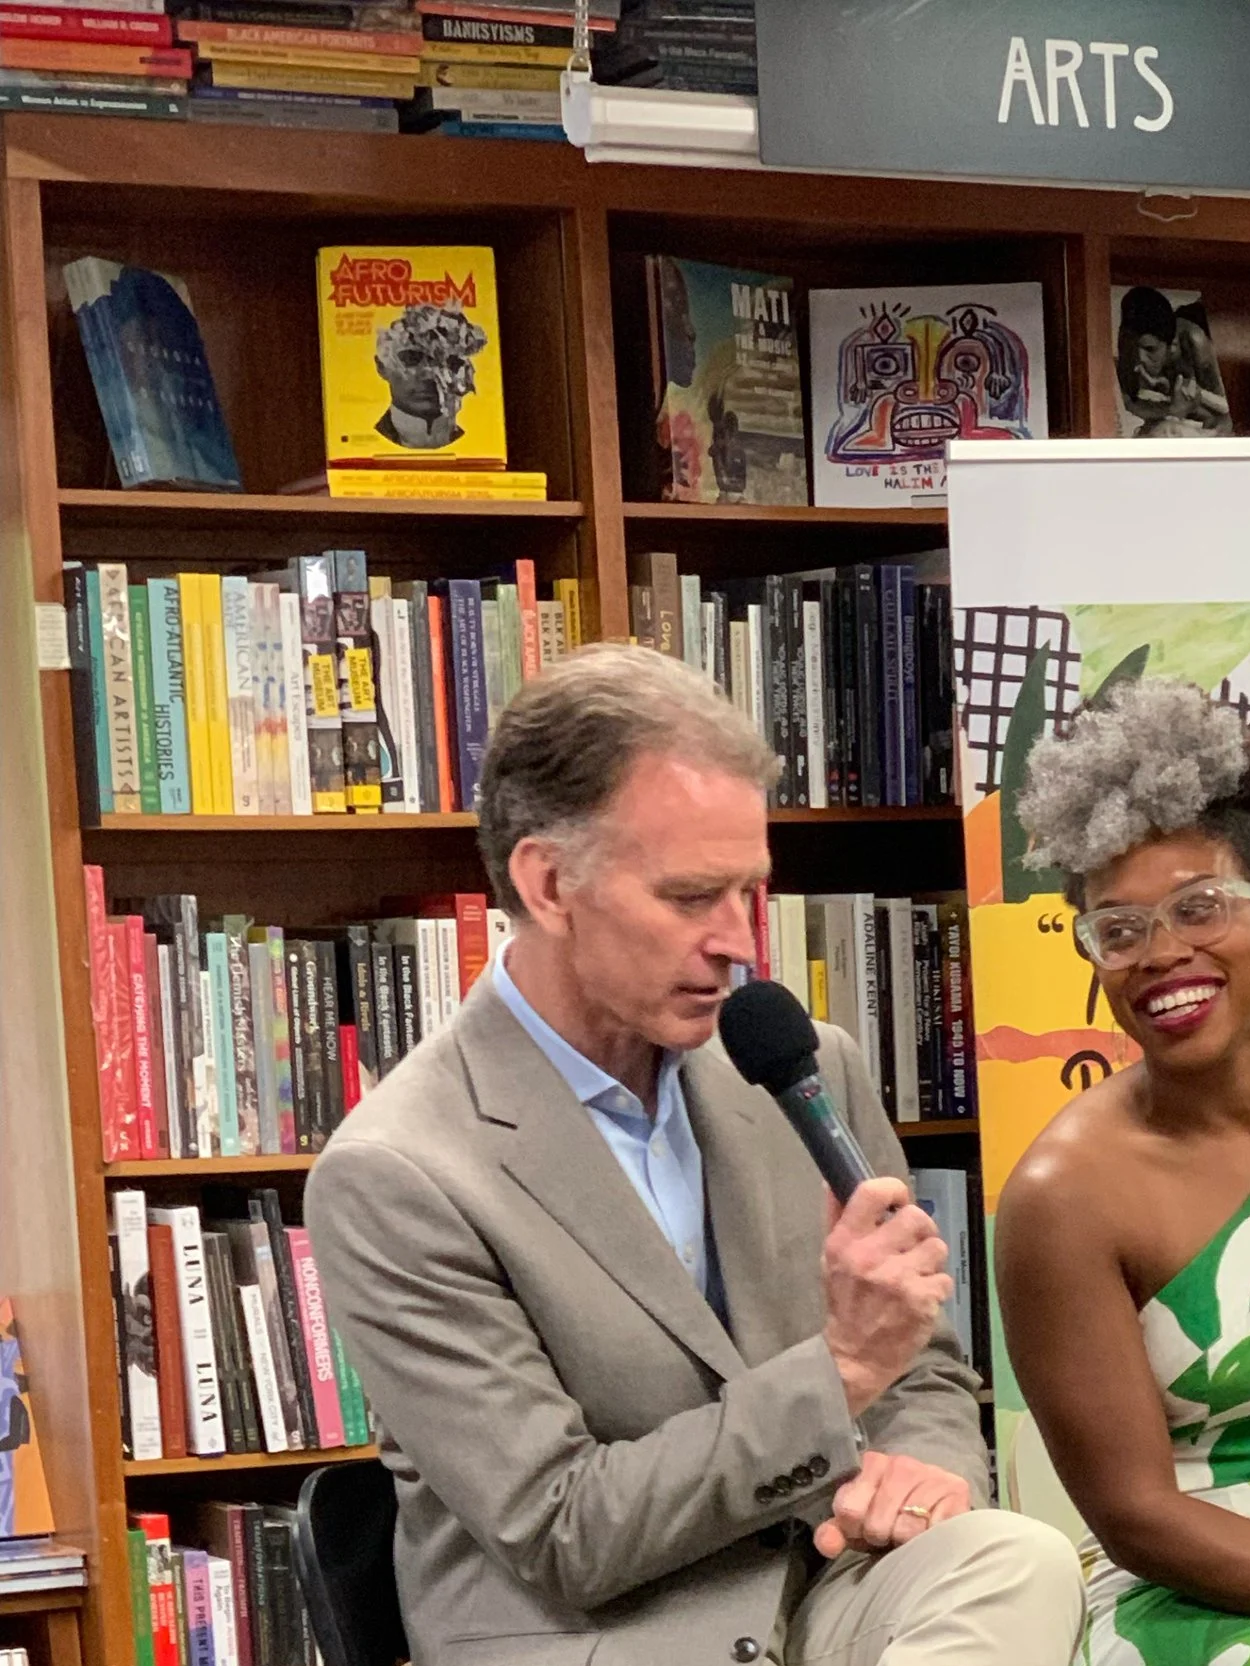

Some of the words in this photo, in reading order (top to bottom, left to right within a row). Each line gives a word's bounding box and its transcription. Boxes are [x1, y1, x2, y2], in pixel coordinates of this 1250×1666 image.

[442, 18, 536, 45] BANKSYISMS
[998, 36, 1174, 132] ARTS
[333, 255, 410, 282] AFRO
[333, 273, 476, 306] FUTURISM
[732, 283, 790, 325] MATI
[845, 465, 880, 477] LOVE
[889, 465, 908, 476] IS
[884, 475, 933, 489] HALIM
[108, 586, 127, 683] AFRCAN
[541, 612, 549, 634] BLK
[555, 612, 563, 634] BLK
[163, 586, 185, 704] AFRO-ATLANTIC
[235, 591, 252, 691] AMERICAN
[323, 663, 332, 684] THE
[349, 656, 362, 705] MUSEUM
[359, 657, 369, 679] THE
[312, 662, 326, 711] MUSEUM
[327, 686, 336, 709] ART
[363, 680, 372, 702] ART
[113, 695, 133, 779] ARTISTS
[154, 703, 175, 781] HISTORIES
[864, 912, 877, 976] ADALINE
[946, 924, 961, 948] YAYOI
[378, 956, 388, 966] In
[401, 955, 410, 965] In
[379, 967, 388, 983] the
[402, 966, 411, 983] the
[948, 962, 963, 1014] KUSAMA
[132, 972, 147, 1032] CATCHING
[305, 960, 320, 1035] Groundwork
[323, 976, 334, 1008] HEAR
[379, 984, 390, 1012] Black
[402, 984, 412, 1010] Black
[866, 979, 878, 1019] KENT
[325, 1010, 335, 1029] ME
[137, 1035, 148, 1057] THE
[326, 1031, 337, 1062] NOW
[953, 1051, 965, 1065] TO
[138, 1059, 152, 1109] MOMENT
[953, 1066, 966, 1098] NOW
[183, 1244, 205, 1306] LUNA
[249, 1293, 264, 1336] MURALS
[300, 1256, 333, 1383] NONCONFORMERS
[258, 1352, 270, 1376] NEW
[196, 1362, 218, 1424] LUNA
[262, 1377, 274, 1403] YORK
[267, 1404, 279, 1427] CITY
[192, 1578, 204, 1602] THIS
[215, 1585, 227, 1611] Again
[223, 1597, 233, 1624] Begin
[194, 1606, 209, 1652] PRESENT
